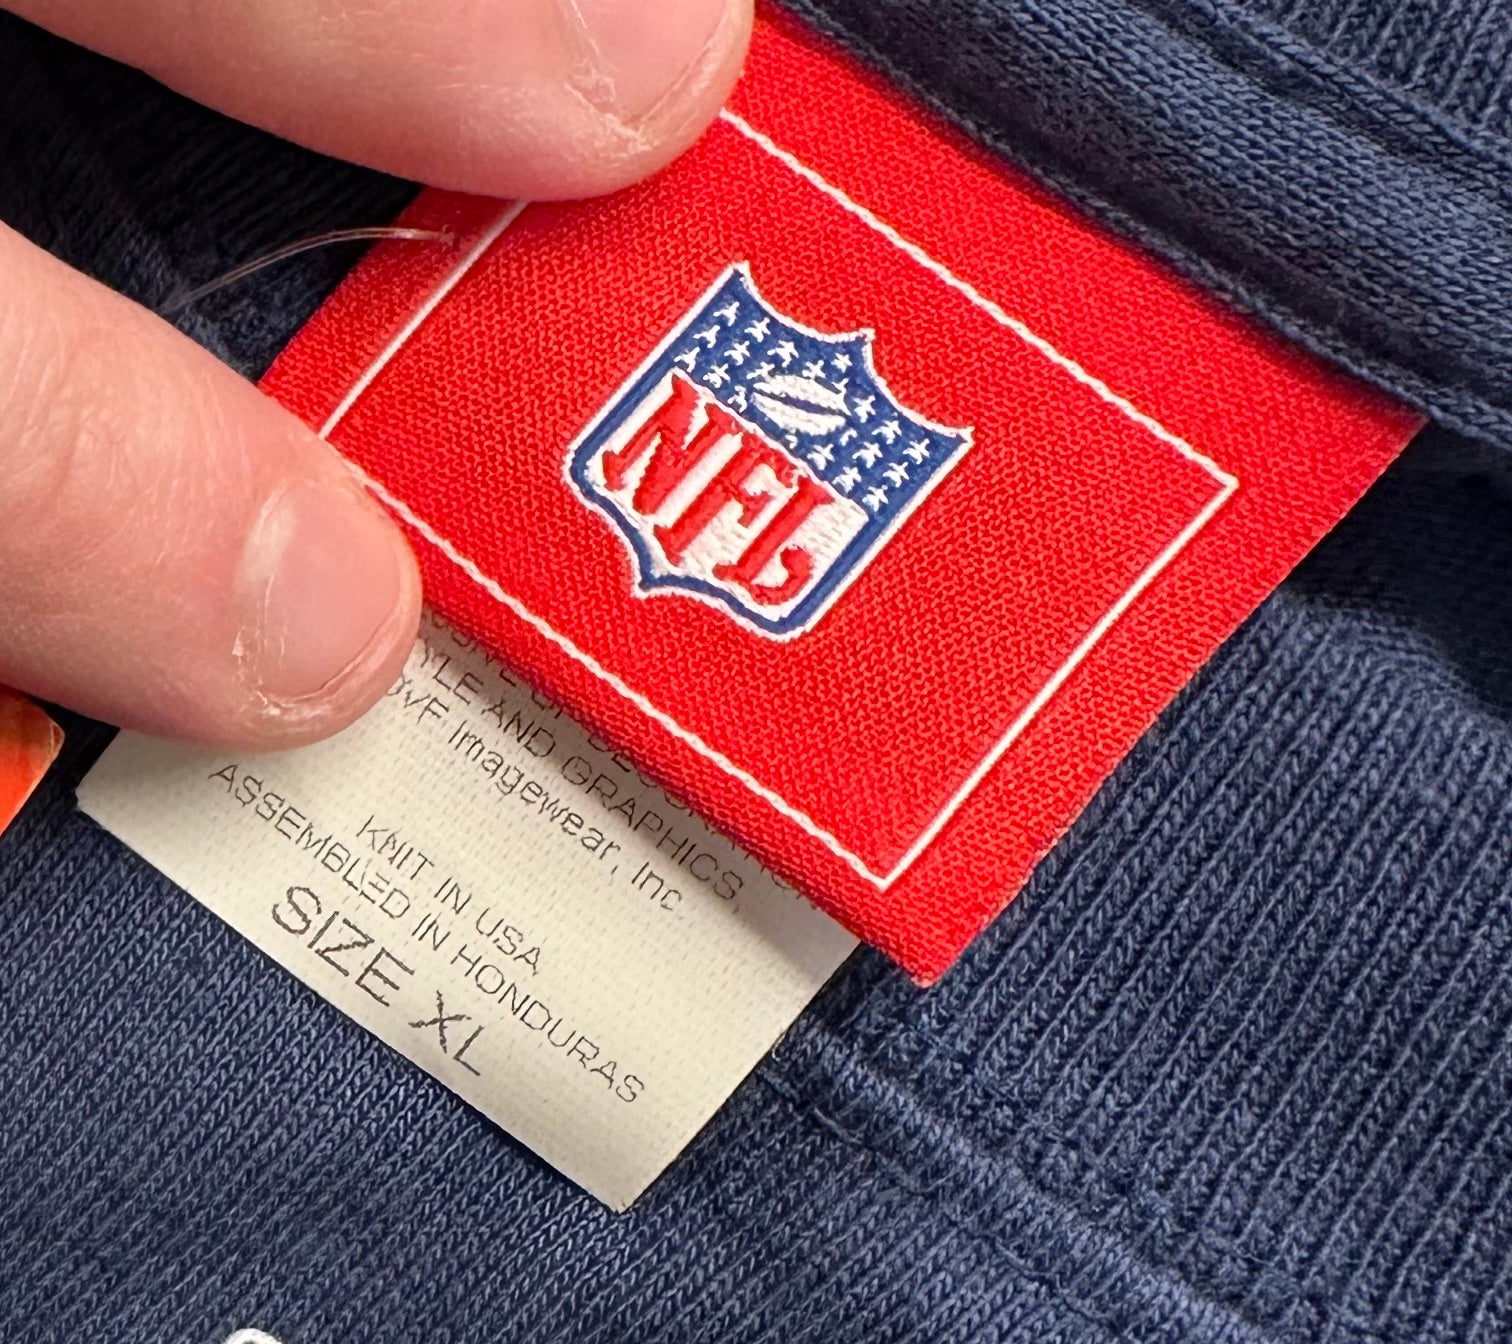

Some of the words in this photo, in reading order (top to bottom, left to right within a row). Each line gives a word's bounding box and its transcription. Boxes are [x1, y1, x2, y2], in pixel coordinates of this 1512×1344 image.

[601, 373, 836, 606] NFL
[448, 719, 622, 875] Imagewear,
[481, 697, 556, 758] AND
[207, 763, 411, 920] ASSEMBLED
[411, 912, 451, 952] IN
[449, 943, 646, 1103] HONDURAS
[271, 885, 416, 1008] SIZE
[407, 989, 486, 1077] XL
[355, 814, 436, 880] KNIT
[433, 876, 473, 916] IN
[474, 907, 544, 976] USA
